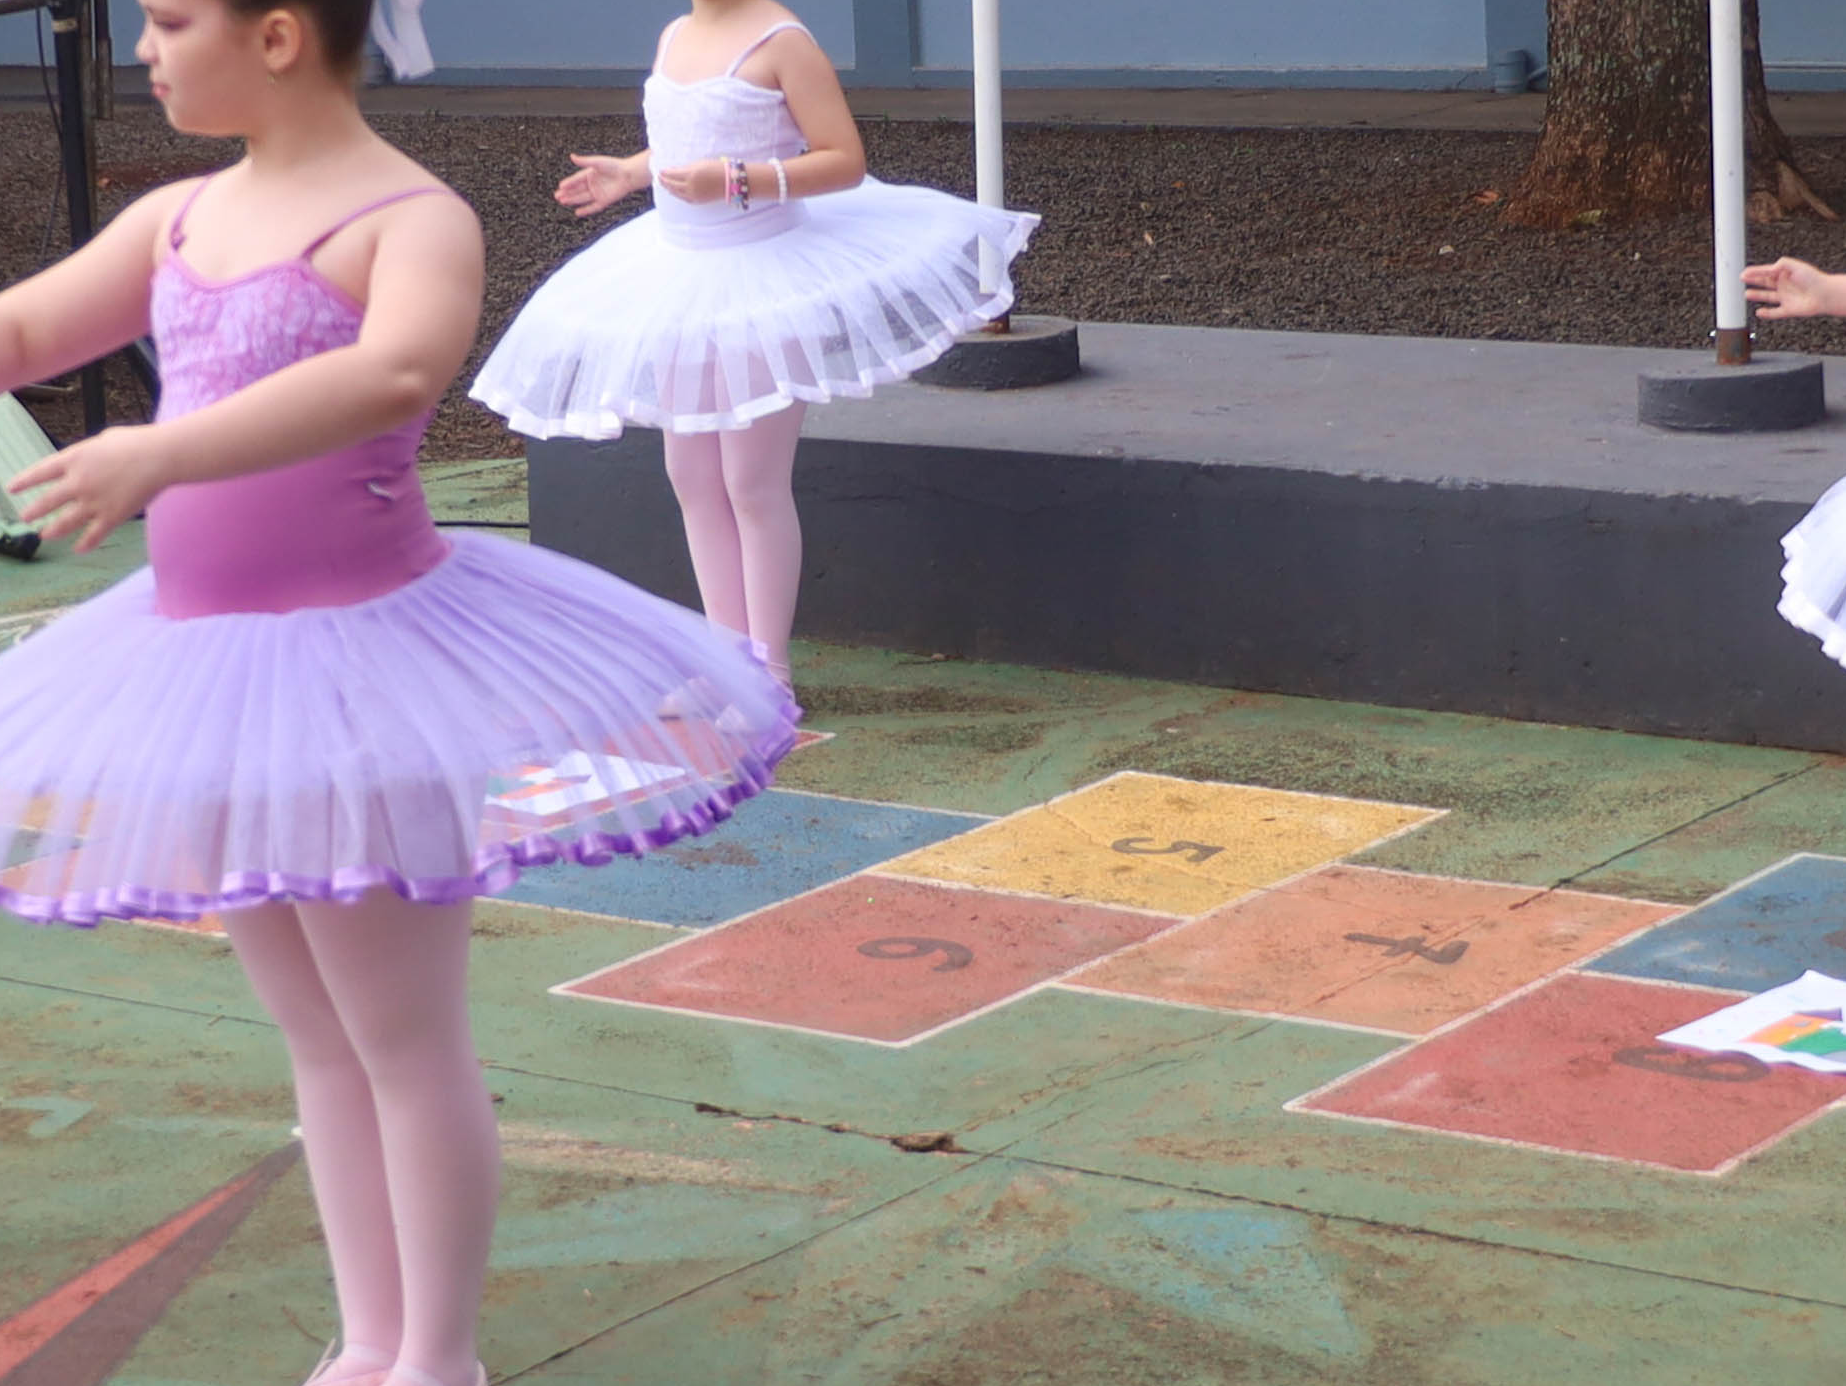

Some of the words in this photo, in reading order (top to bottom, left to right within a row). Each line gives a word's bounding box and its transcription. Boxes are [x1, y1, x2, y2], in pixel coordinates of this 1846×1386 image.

[1111, 836, 1225, 863] 5
[857, 935, 974, 973] 6
[1343, 932, 1469, 965] 7
